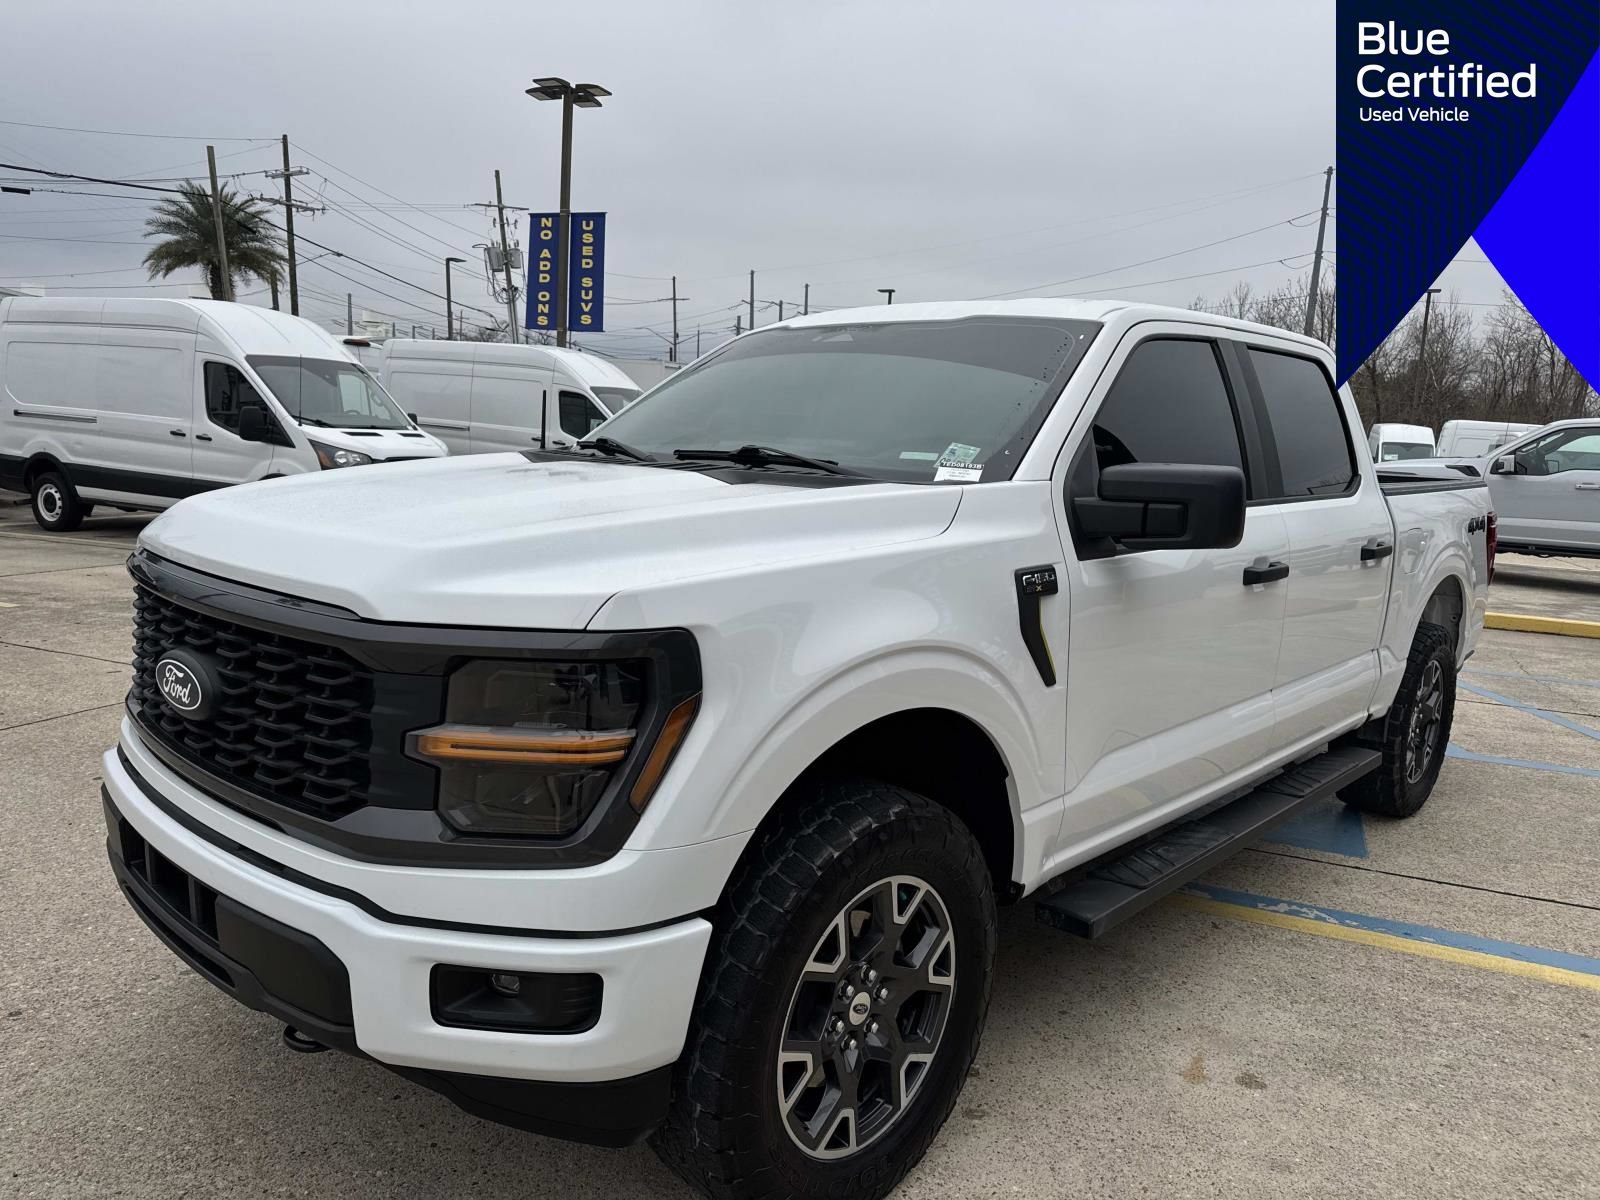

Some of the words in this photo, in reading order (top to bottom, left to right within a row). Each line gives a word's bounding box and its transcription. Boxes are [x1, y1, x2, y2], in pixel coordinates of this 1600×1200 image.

[540, 217, 553, 240] NO
[581, 219, 594, 269] USED
[538, 248, 552, 283] ADD
[536, 291, 551, 326] ONS
[579, 277, 593, 325] SUVS
[163, 664, 192, 704] Ford
